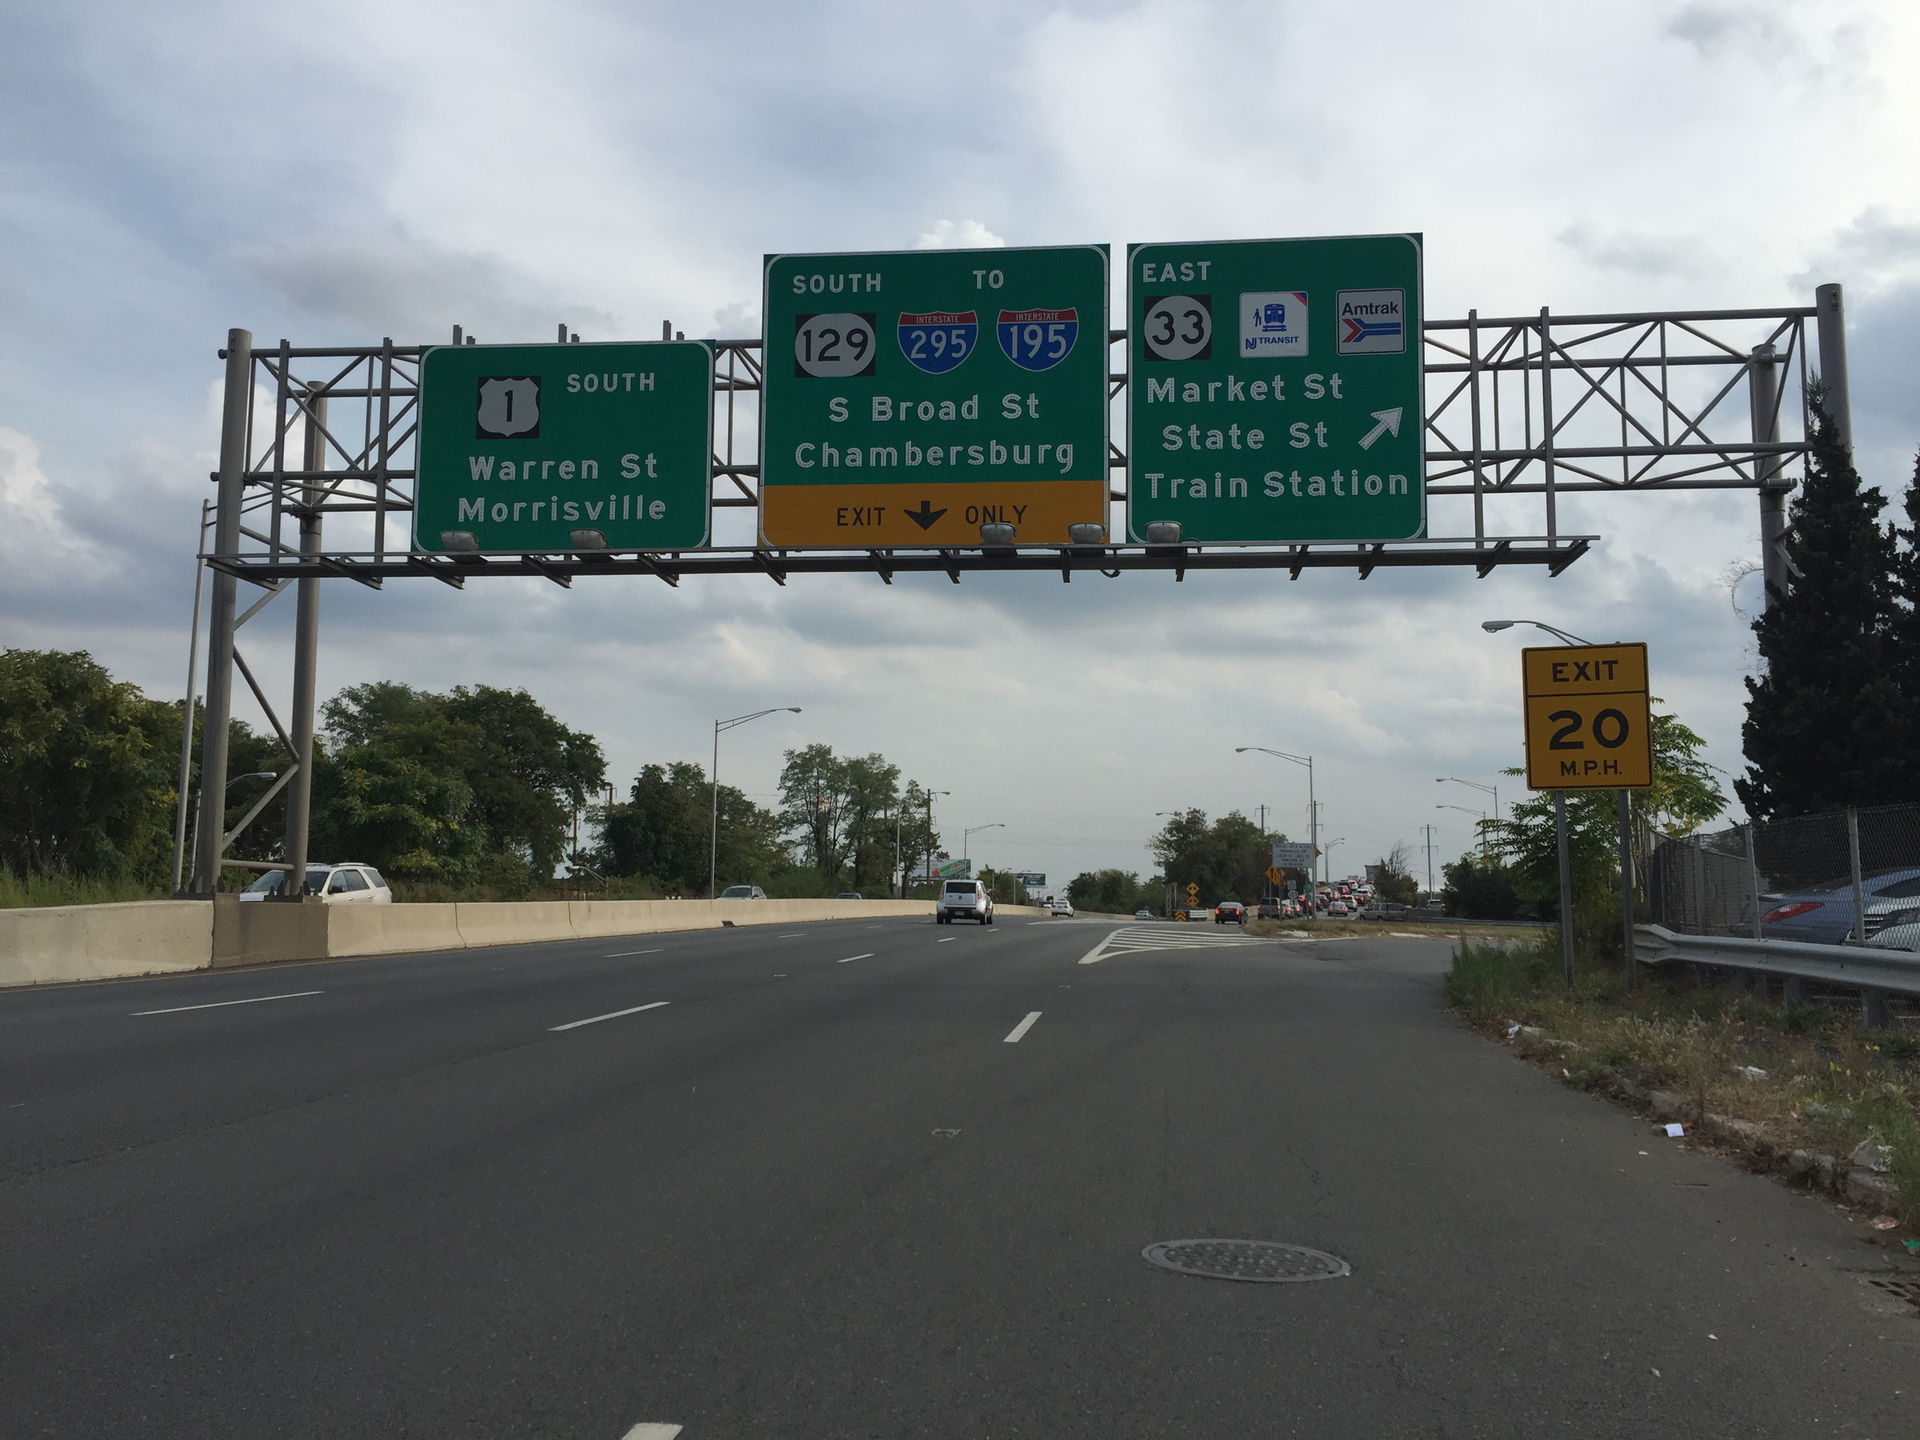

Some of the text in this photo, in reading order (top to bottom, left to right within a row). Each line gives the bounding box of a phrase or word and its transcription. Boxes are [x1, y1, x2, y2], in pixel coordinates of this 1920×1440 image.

[792, 273, 882, 294] SOUTH
[973, 270, 1004, 289] TO
[1142, 261, 1212, 283] EAST
[916, 315, 959, 324] INTERSTATE
[1015, 312, 1059, 321] INTERSTATE
[1342, 301, 1399, 316] Amtrak
[1152, 310, 1205, 345] 33
[803, 328, 869, 362] 129
[910, 329, 967, 359] 295
[1010, 324, 1066, 359] 195
[1245, 336, 1299, 350] NJ TRANSIT
[567, 373, 655, 392] SOUTH
[1147, 373, 1343, 403] Market St
[504, 390, 513, 422] 1
[829, 393, 1039, 422] S Broad St
[1162, 422, 1328, 450] State St
[469, 453, 658, 480] Warren St
[795, 439, 1073, 474] Chambersburg
[1145, 470, 1408, 498] Train Station
[458, 495, 666, 522] Morrisville
[836, 505, 1028, 526] EXIT ONLY
[1552, 660, 1618, 682] EXIT
[1548, 709, 1629, 750] 20
[1561, 760, 1622, 776] M.P.H.
